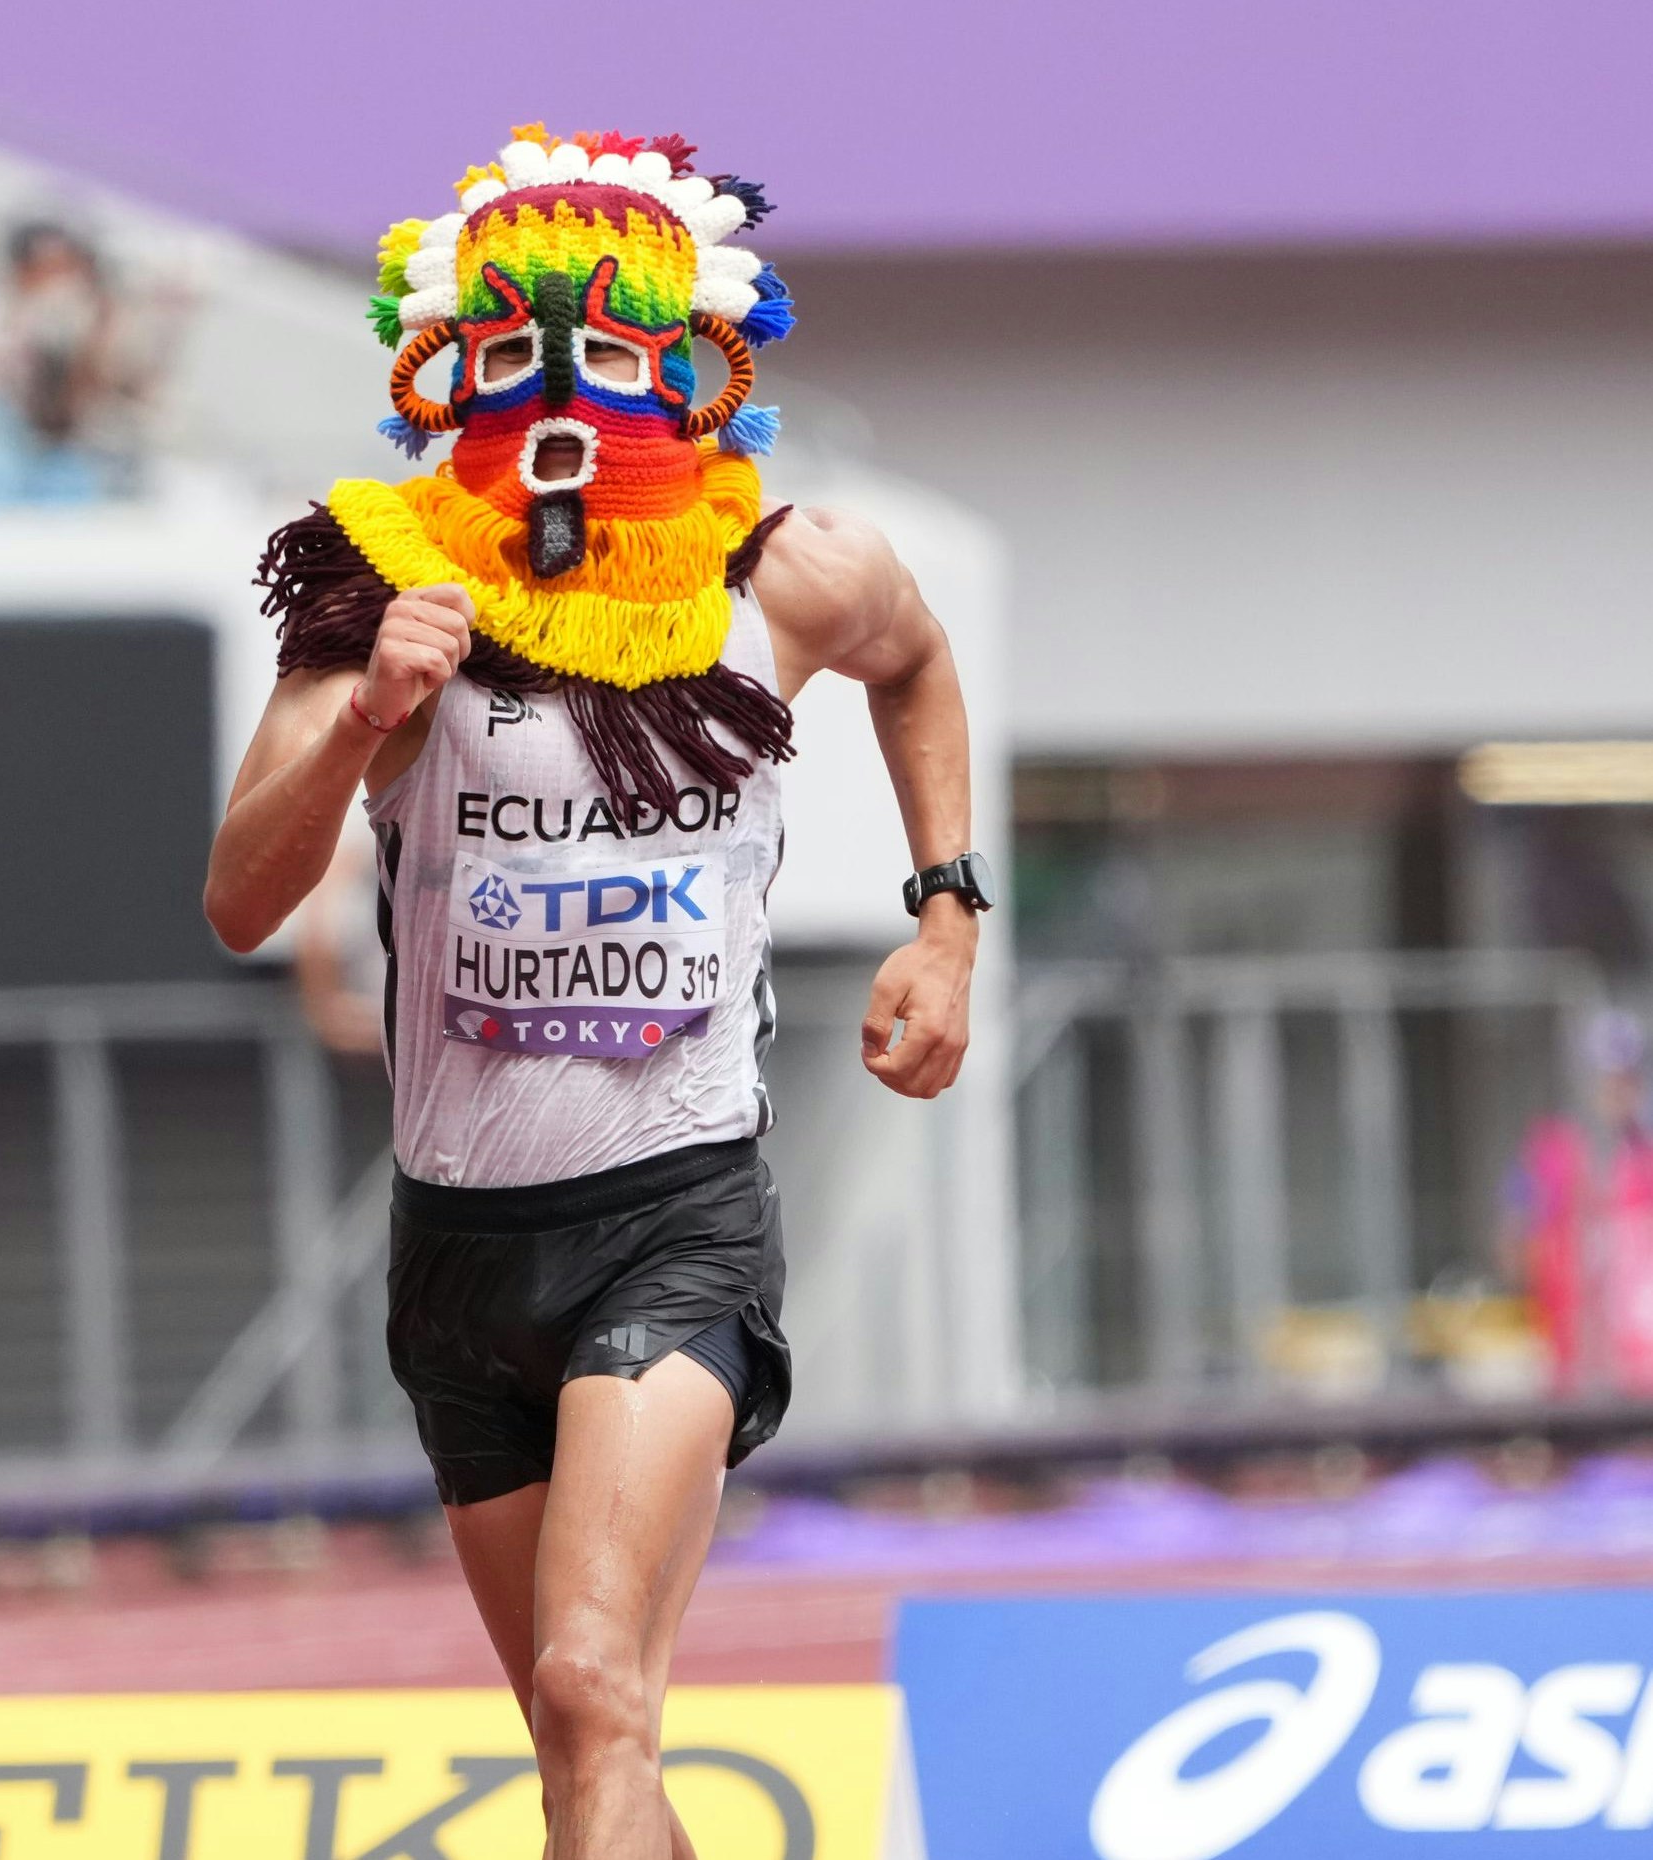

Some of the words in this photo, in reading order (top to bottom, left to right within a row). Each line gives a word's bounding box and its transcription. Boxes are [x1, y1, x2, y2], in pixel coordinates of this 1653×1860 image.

[457, 786, 741, 843] ECUADOR
[521, 866, 708, 932] TDK
[455, 935, 668, 1000] HURTADO
[681, 952, 720, 1001] 319
